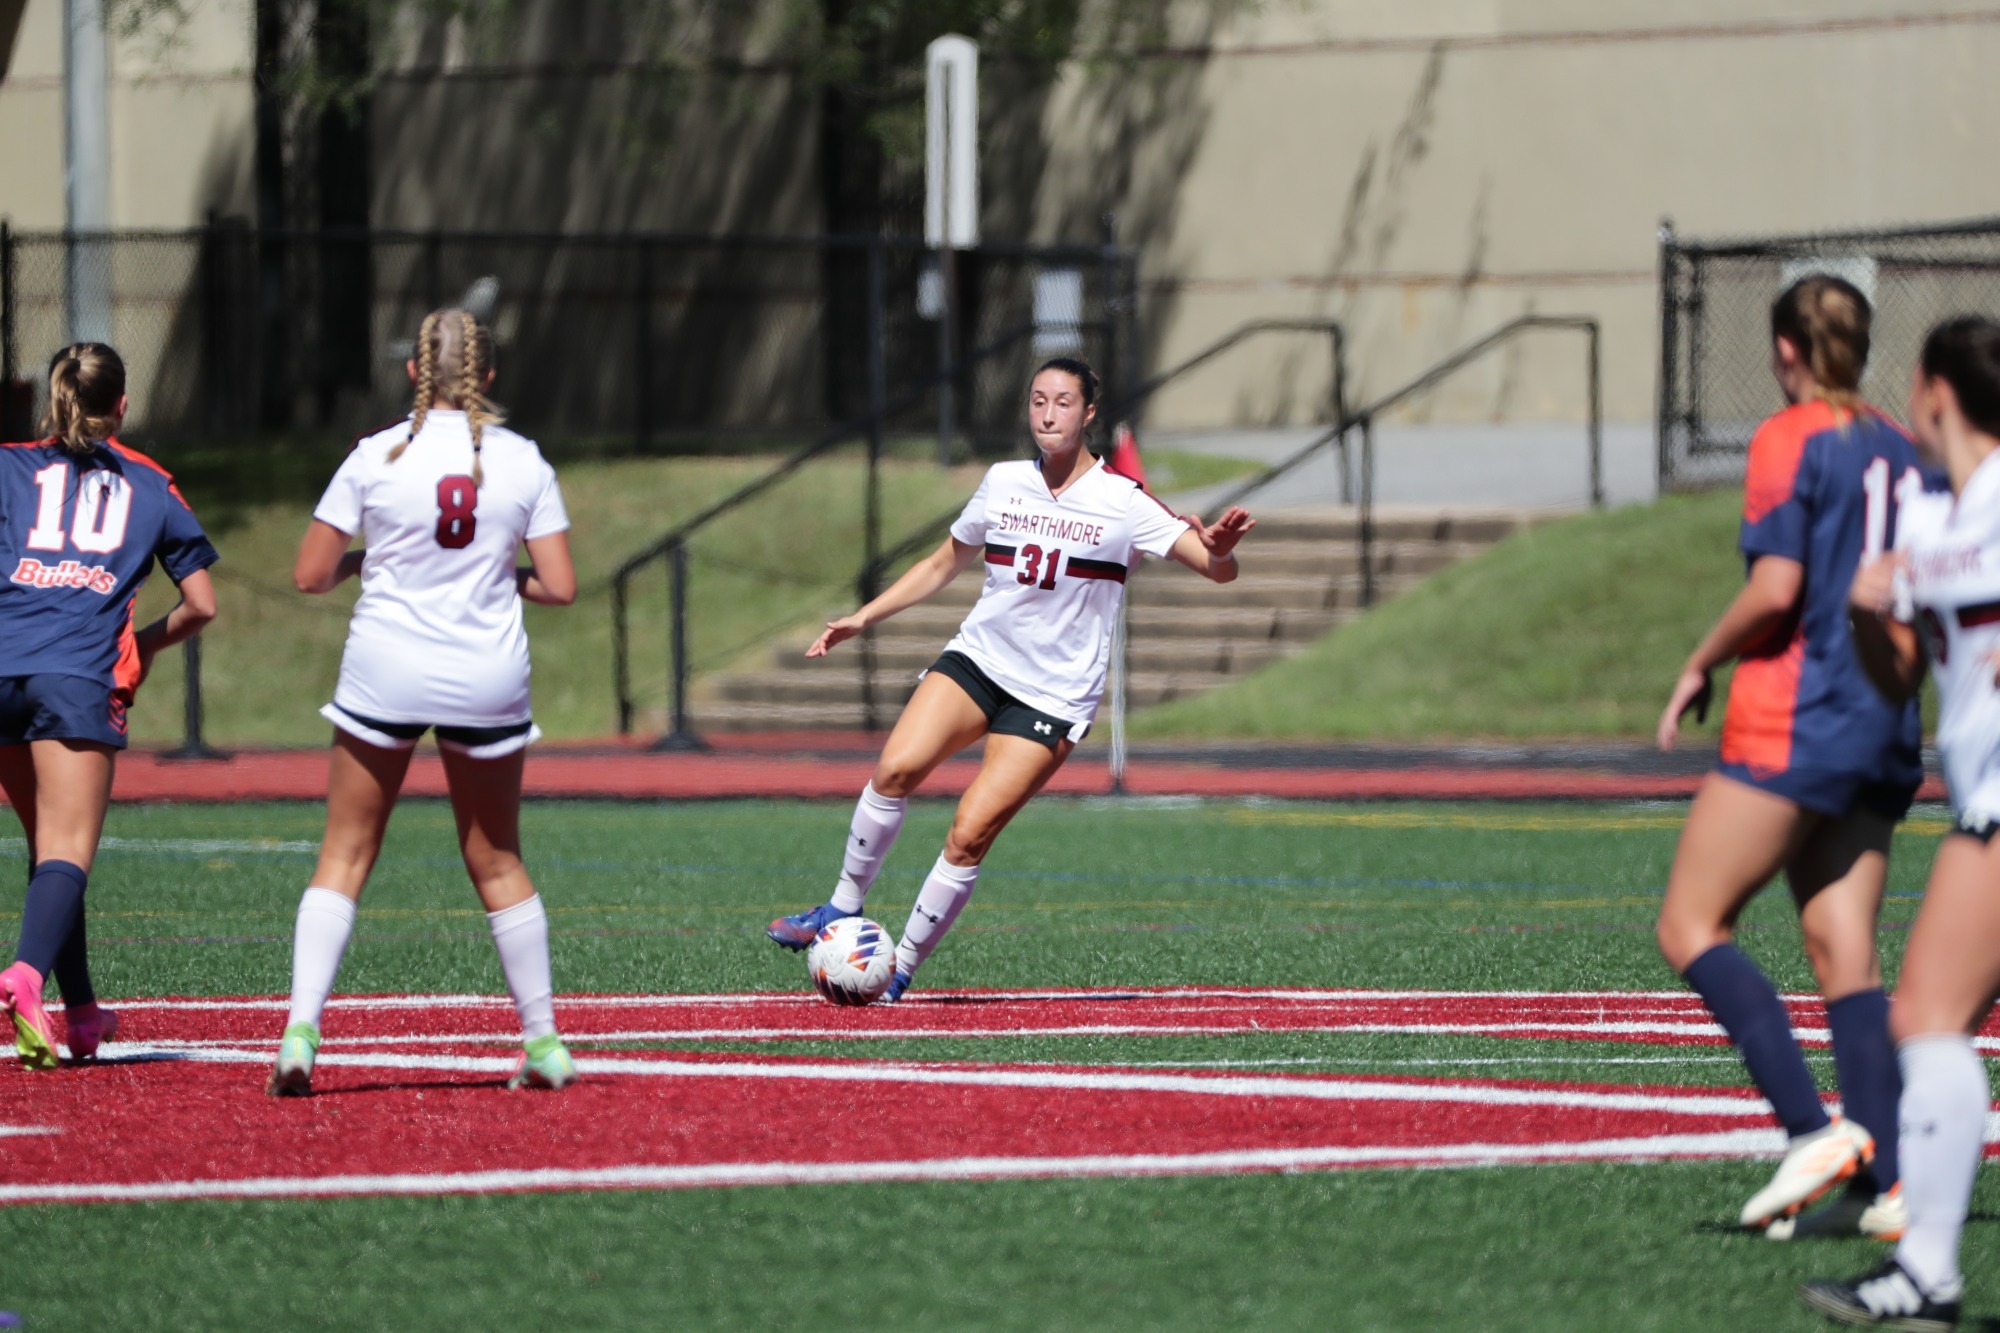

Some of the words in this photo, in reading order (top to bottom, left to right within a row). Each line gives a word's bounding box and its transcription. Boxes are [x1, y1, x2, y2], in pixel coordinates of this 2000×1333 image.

[26, 462, 133, 555] 10
[435, 474, 478, 549] 8
[999, 512, 1104, 546] SWARTHMORE
[10, 558, 118, 595] Bullets
[1016, 543, 1061, 591] 31
